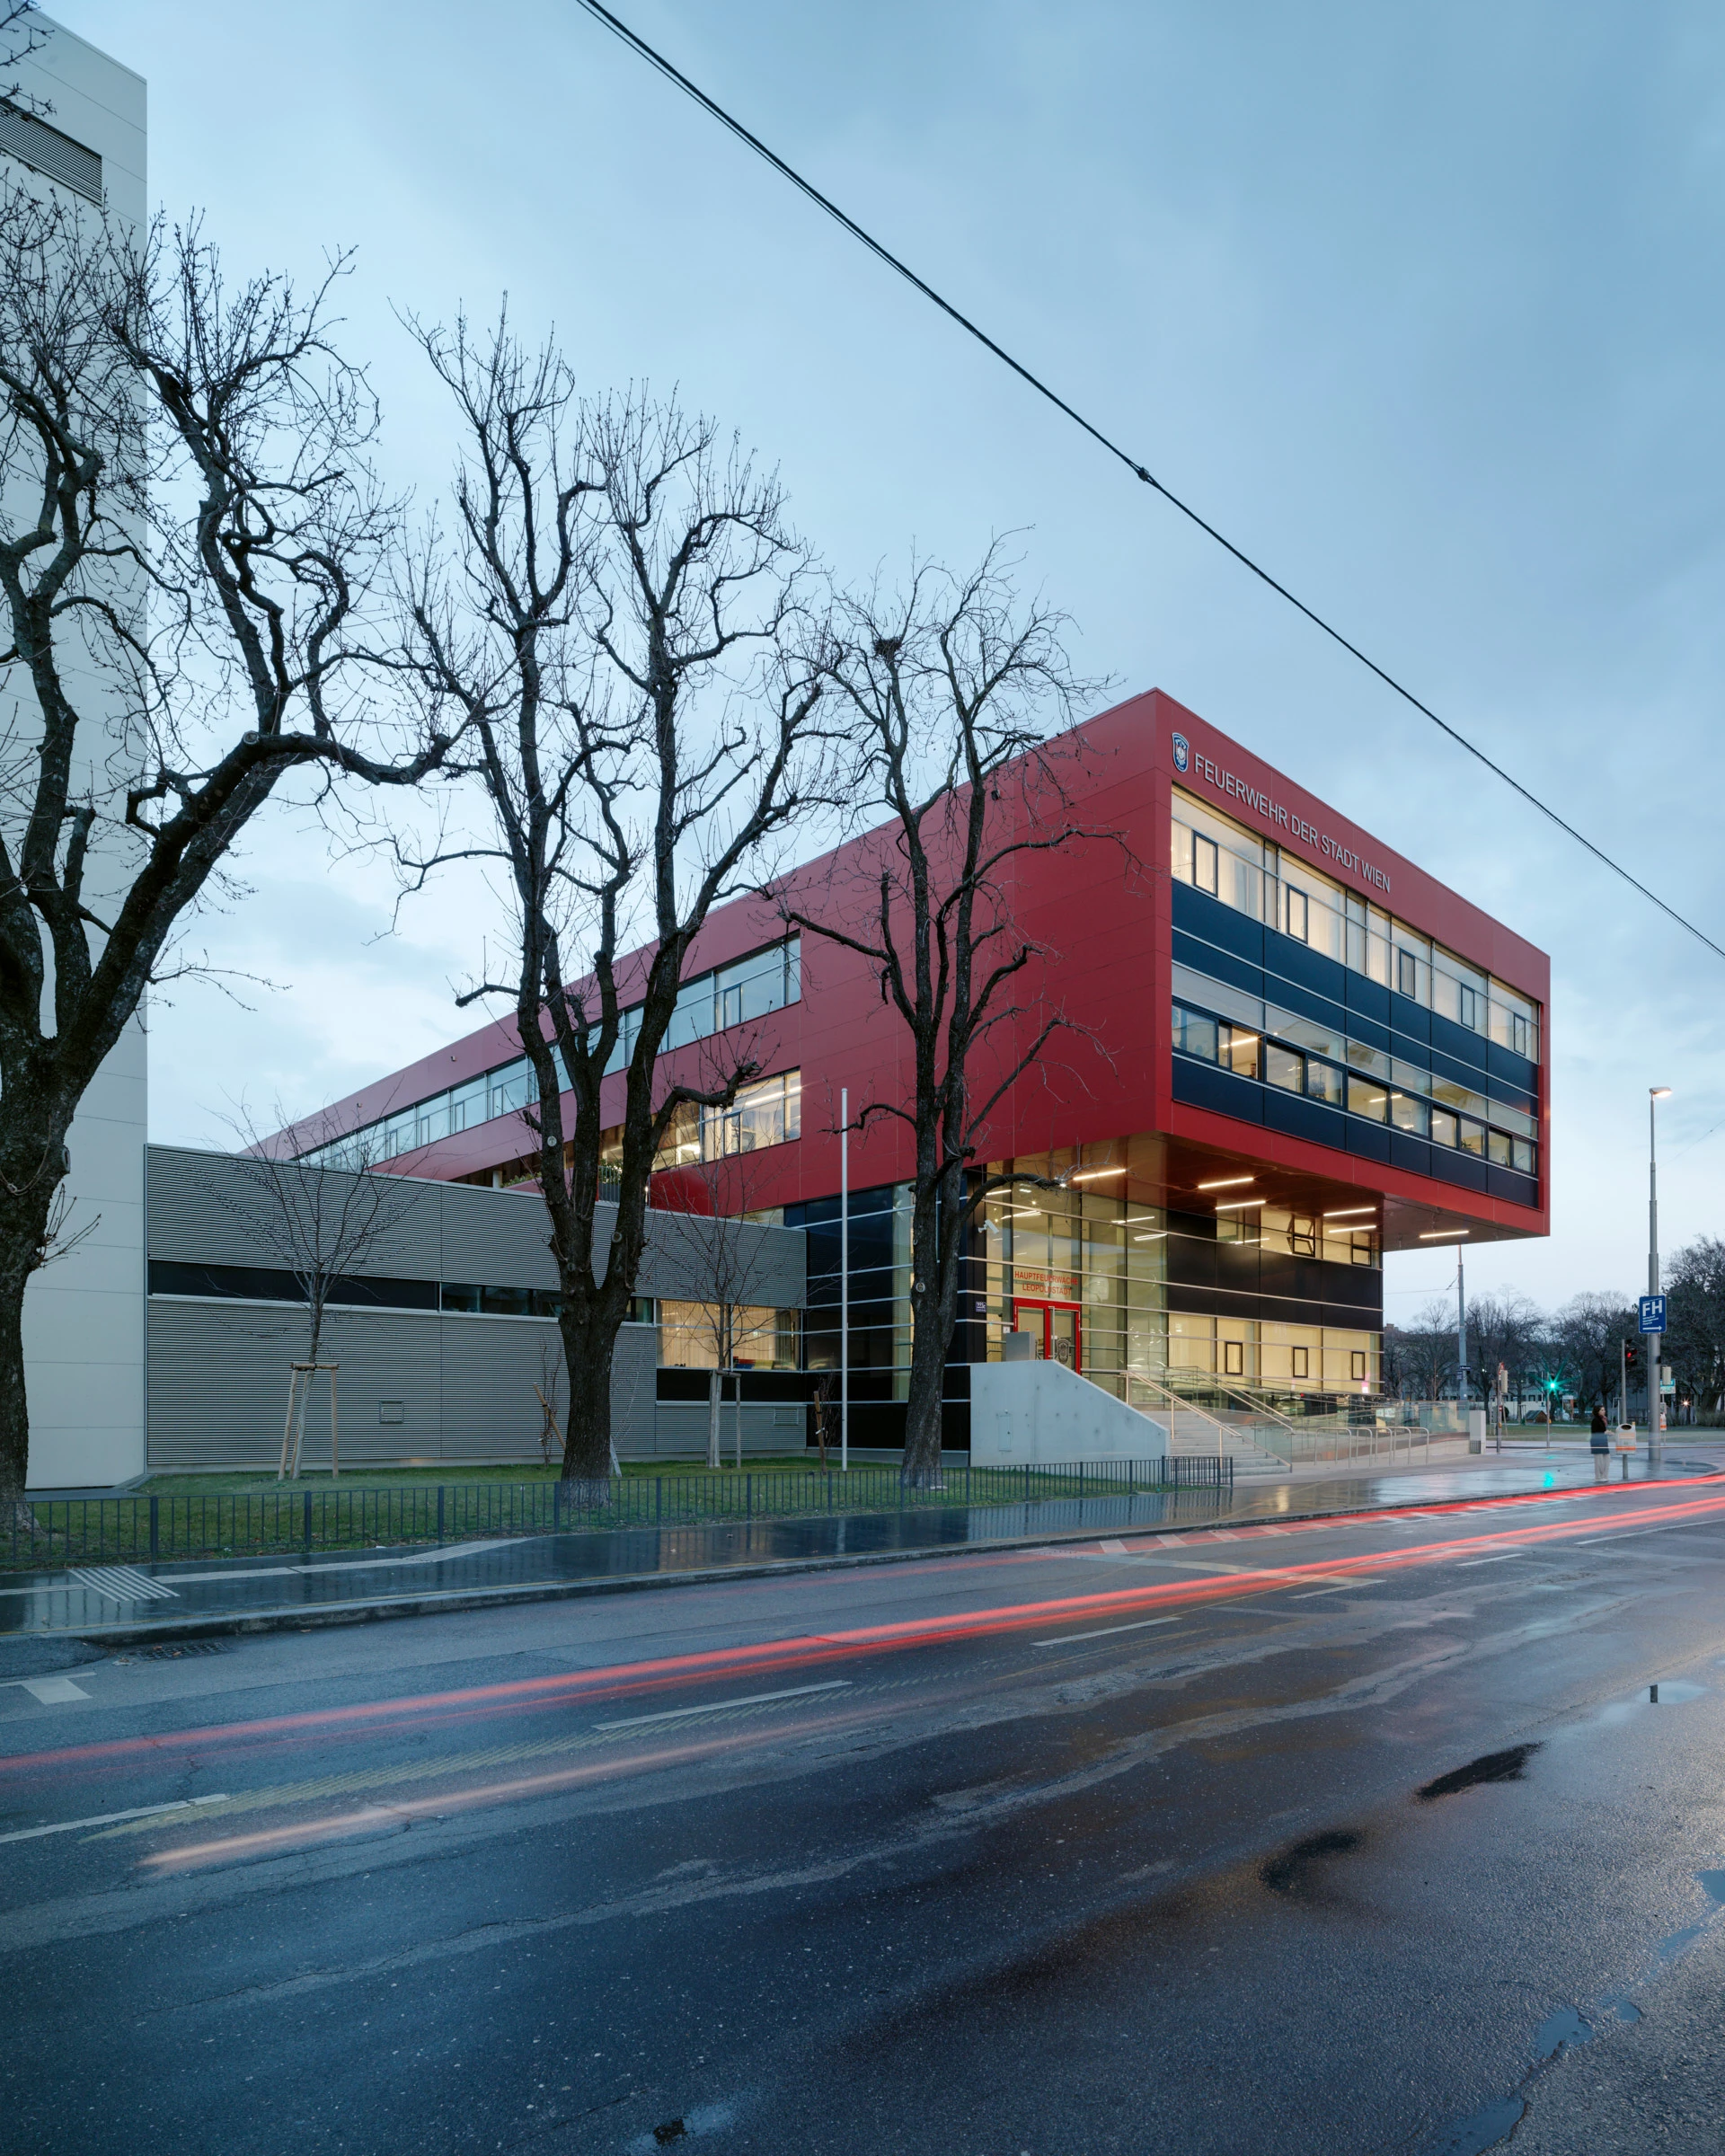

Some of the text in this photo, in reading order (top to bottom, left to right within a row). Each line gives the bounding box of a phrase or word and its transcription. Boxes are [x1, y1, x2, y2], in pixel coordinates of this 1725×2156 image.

[1195, 753, 1391, 893] FEUERWEHR DER STADT WIEN
[1014, 1270, 1079, 1285] HAUPTFEUERWACHE
[1022, 1284, 1072, 1295] LEOPOLDSTADT
[1642, 1299, 1663, 1317] FH
